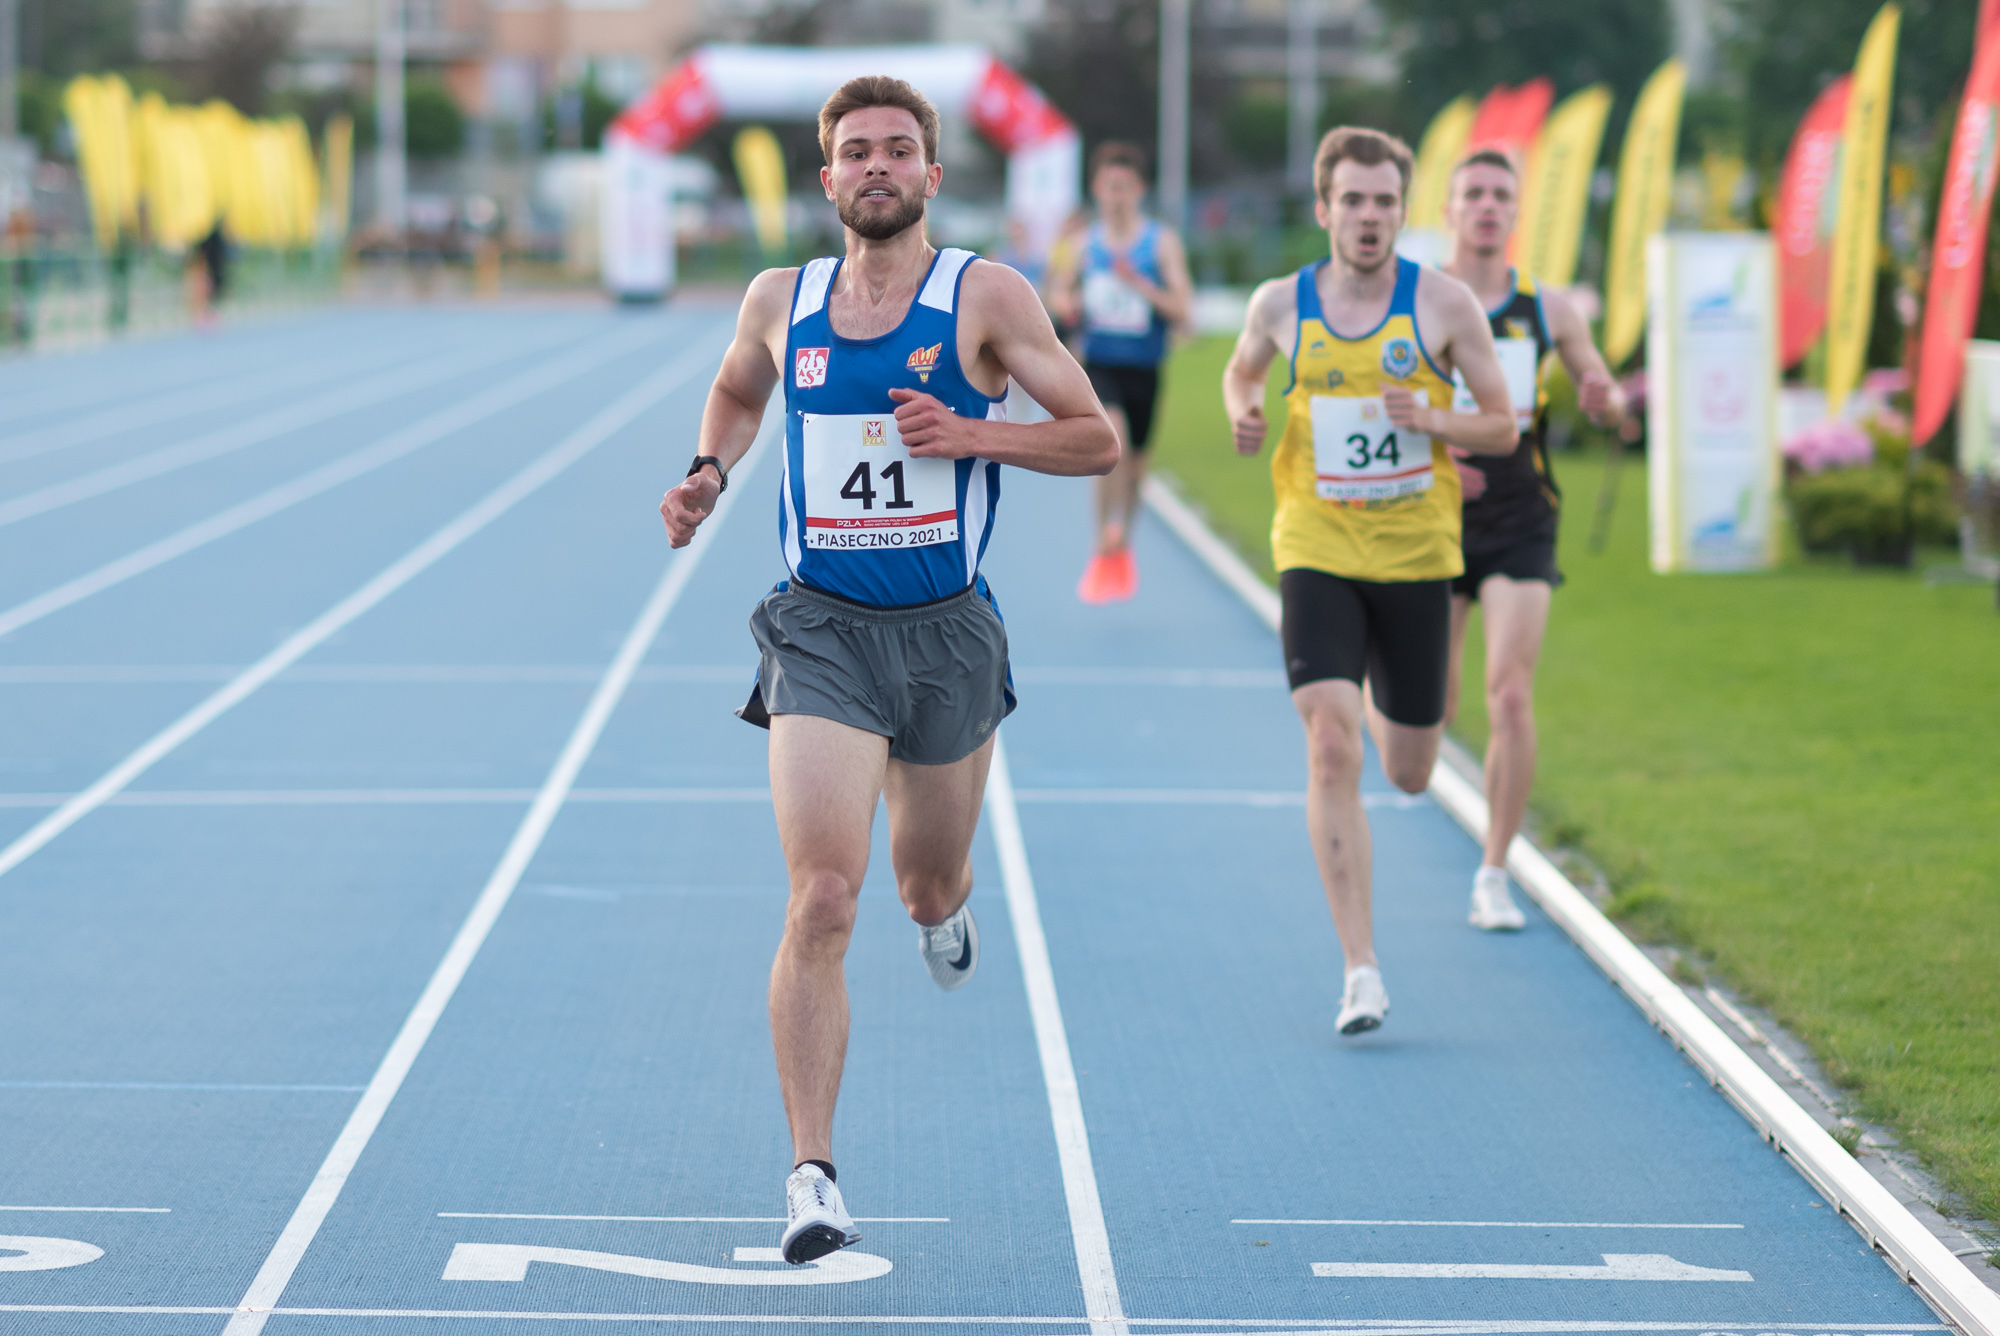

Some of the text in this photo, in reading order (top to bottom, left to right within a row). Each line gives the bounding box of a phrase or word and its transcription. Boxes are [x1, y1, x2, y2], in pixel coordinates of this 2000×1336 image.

[907, 342, 942, 366] AWF
[864, 437, 885, 445] PZLA
[1346, 432, 1401, 469] 34
[840, 460, 914, 510] 41
[1325, 478, 1423, 498] PIASECZNO 2021
[818, 528, 942, 547] PIASECZNO 2021
[440, 1242, 894, 1287] 2
